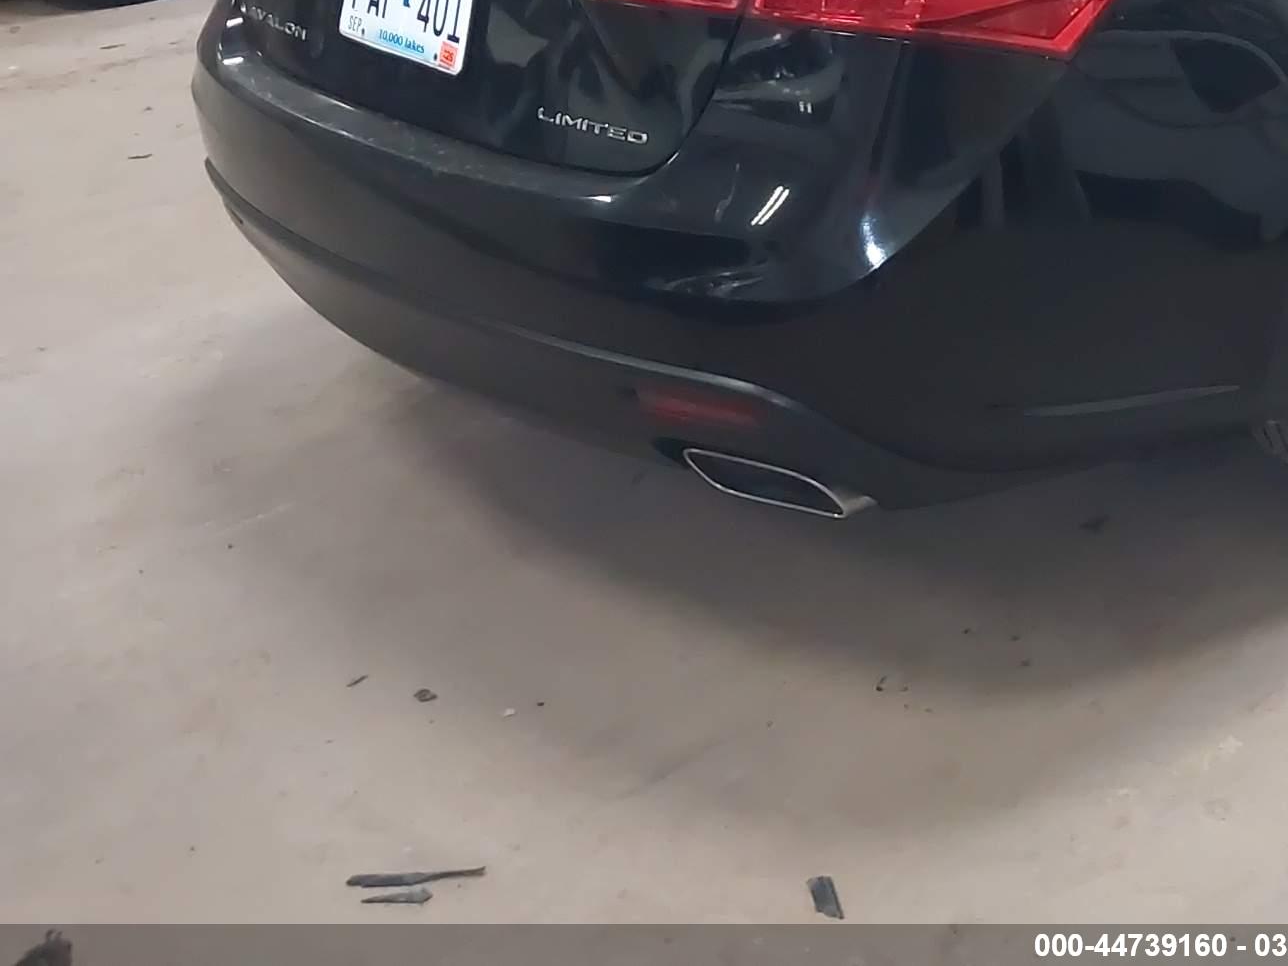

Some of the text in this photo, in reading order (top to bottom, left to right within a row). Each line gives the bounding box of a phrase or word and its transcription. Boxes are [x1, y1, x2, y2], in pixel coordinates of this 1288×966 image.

[379, 29, 425, 53] 10,000 lakes
[538, 107, 648, 144] LIMITED
